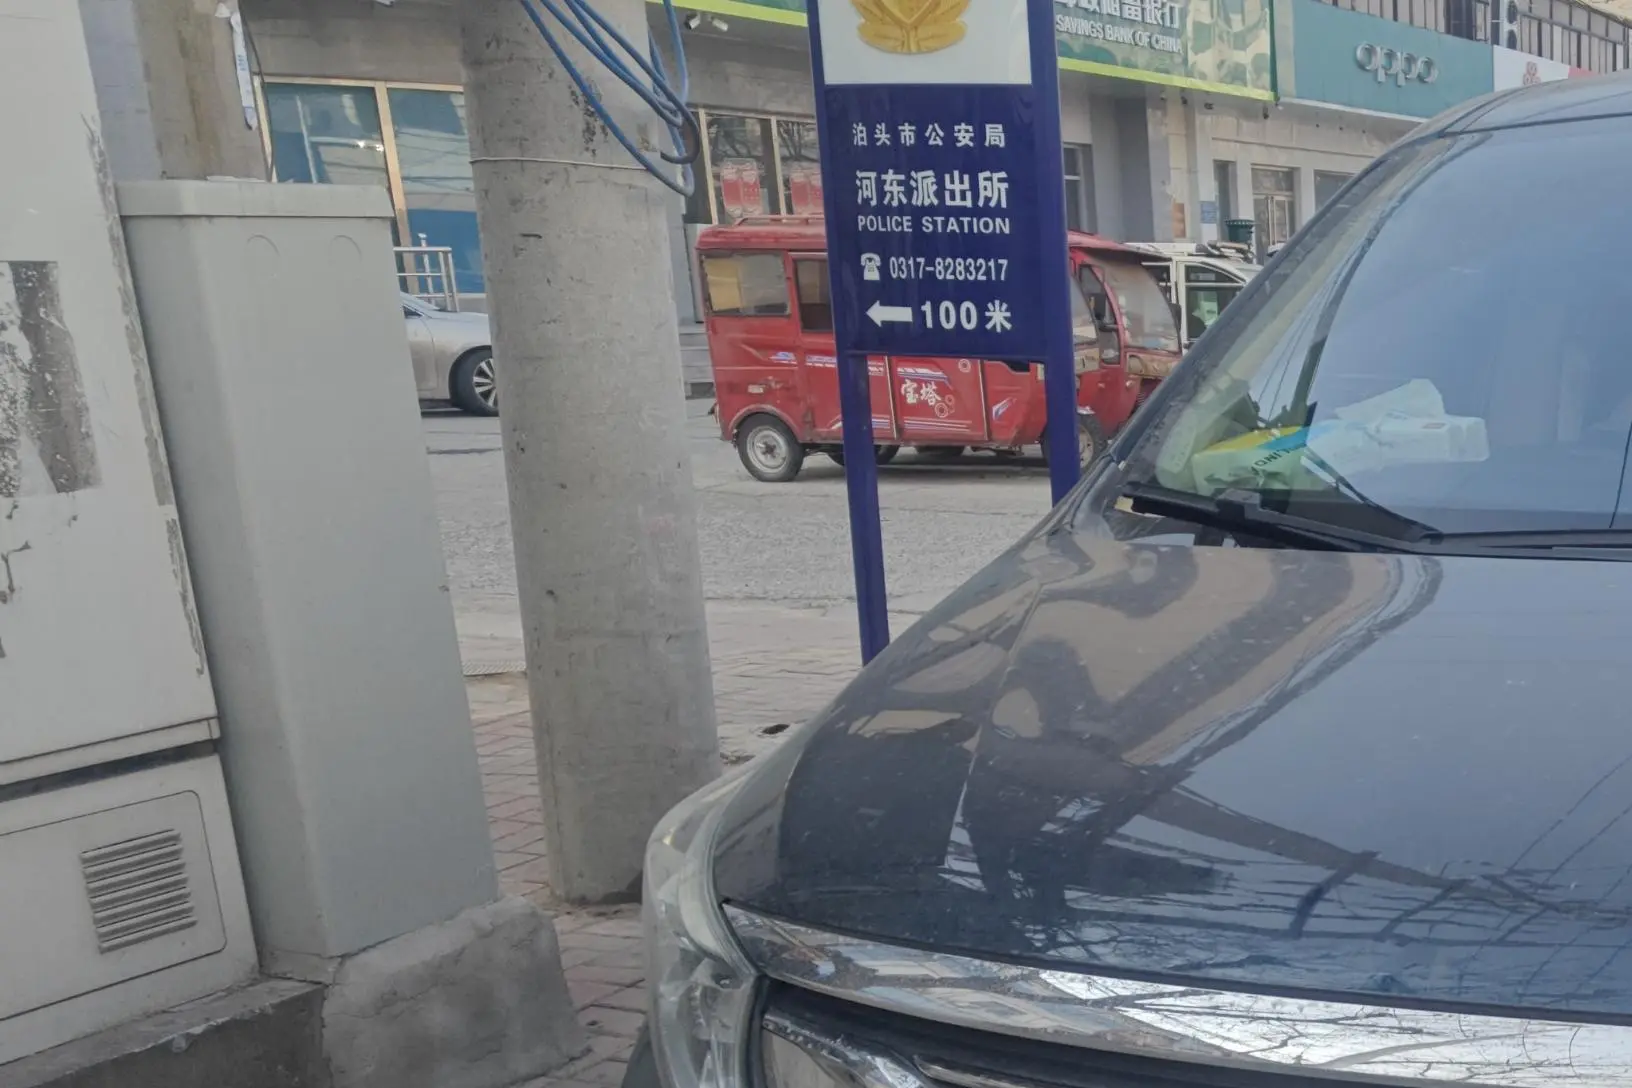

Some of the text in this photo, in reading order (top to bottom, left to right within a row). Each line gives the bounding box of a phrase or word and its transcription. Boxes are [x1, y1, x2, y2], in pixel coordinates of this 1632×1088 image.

[1056, 14, 1183, 54] SAVINGS BANK OF CHINA
[852, 122, 1006, 148] 泊头市公安局
[855, 168, 1010, 209] 河东派出所
[857, 215, 1010, 235] POLICE STATION
[889, 256, 1009, 281] 0317-8283217
[920, 300, 1012, 333] 100米
